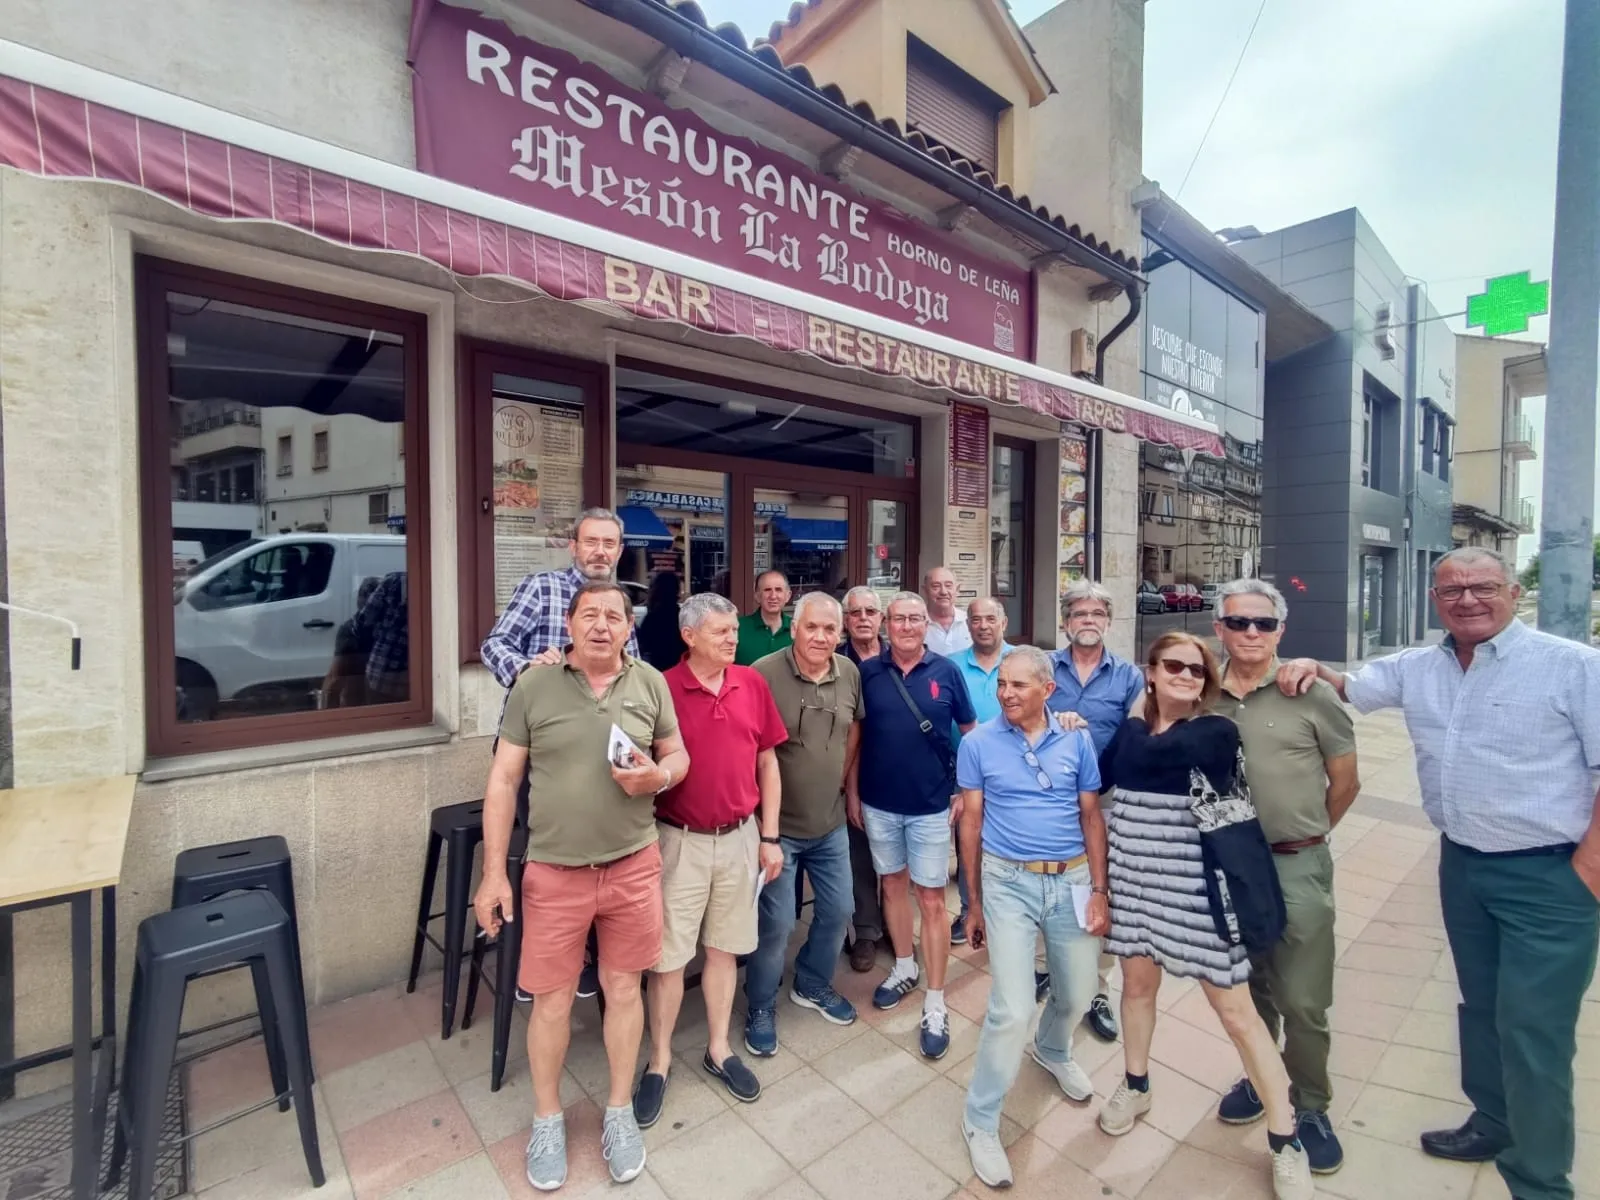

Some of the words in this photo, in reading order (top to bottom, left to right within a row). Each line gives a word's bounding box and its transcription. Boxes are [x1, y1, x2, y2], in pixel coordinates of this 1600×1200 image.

[465, 29, 871, 242] RESTAURANTE
[509, 125, 724, 245] Mesón
[739, 202, 802, 274] La
[816, 232, 950, 328] Bodega
[887, 232, 952, 275] HORNO
[959, 265, 979, 288] DE
[984, 274, 1020, 306] LEÑA
[604, 256, 712, 324] BAR
[807, 314, 1020, 403] RESTAURANTE
[1071, 392, 1125, 431] TAPAS
[1152, 324, 1183, 359] DESCUBRE
[1184, 341, 1197, 366] QUE
[1161, 353, 1189, 384] NUESTRO
[1190, 367, 1215, 394] INTERIOR
